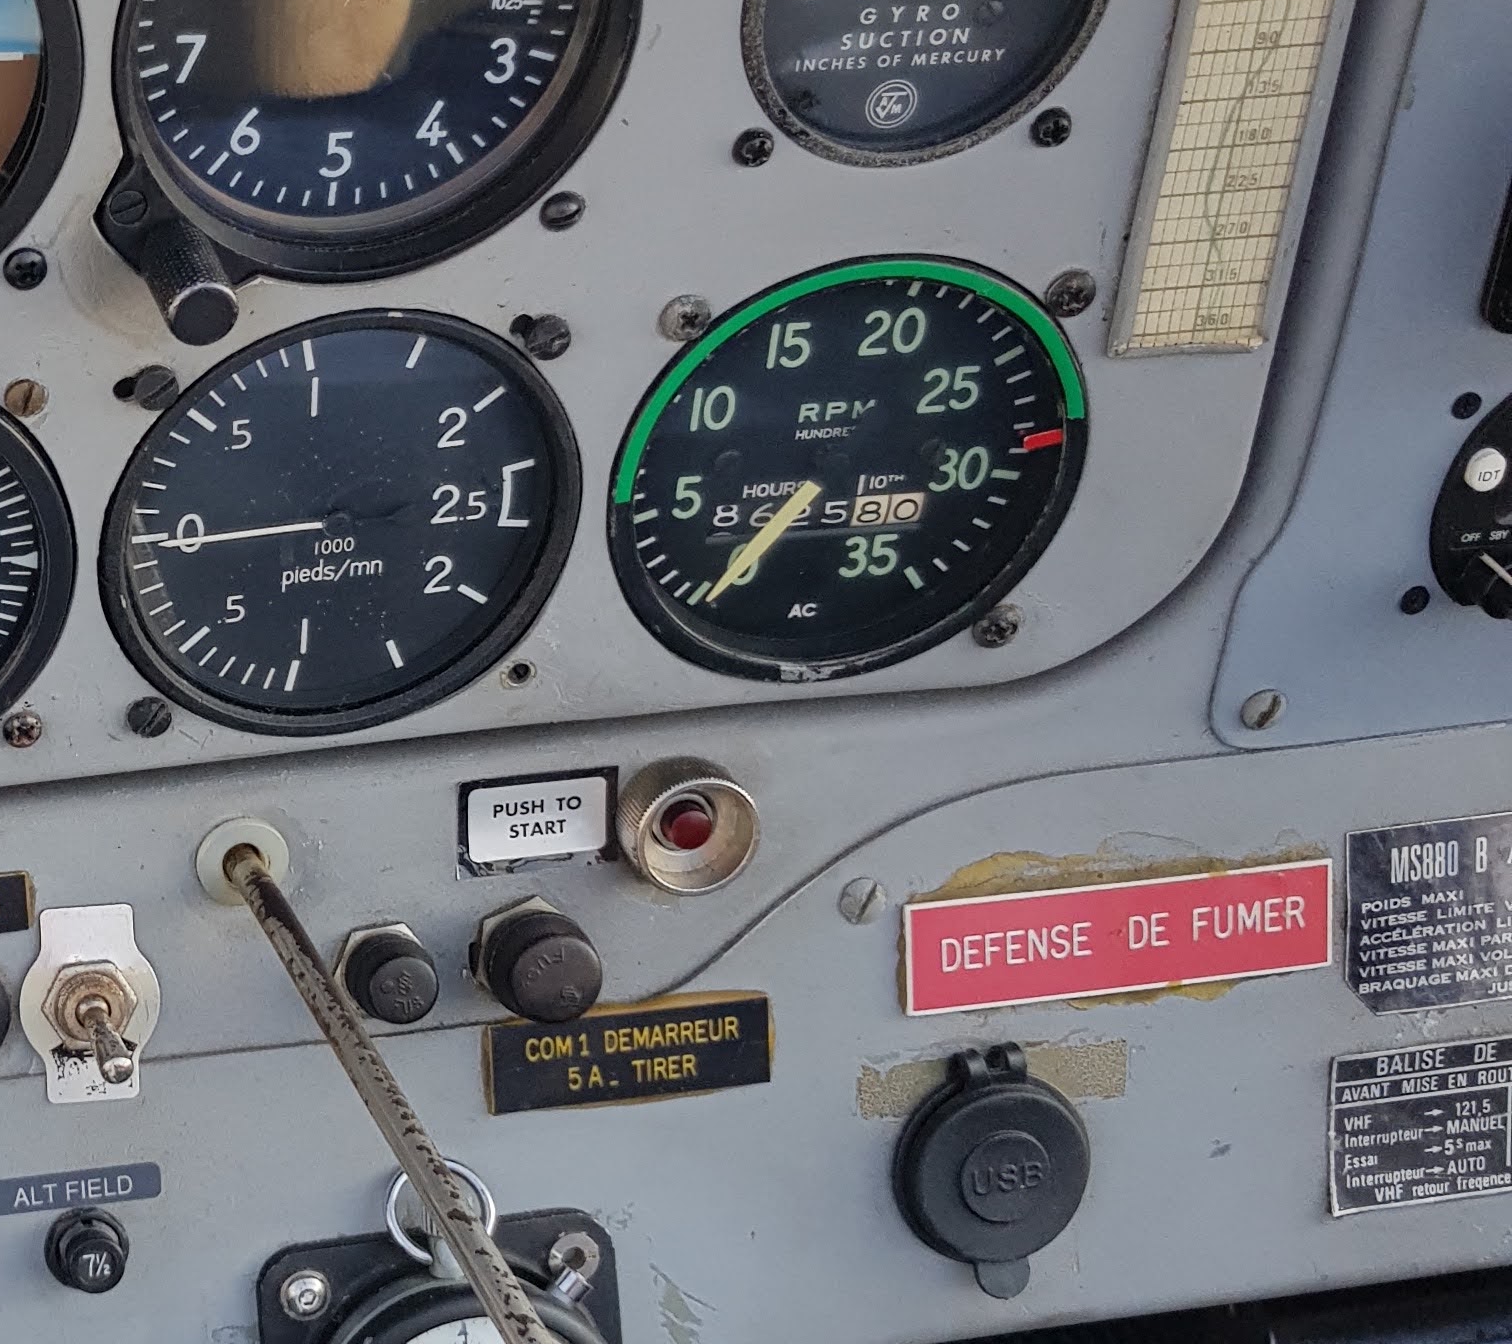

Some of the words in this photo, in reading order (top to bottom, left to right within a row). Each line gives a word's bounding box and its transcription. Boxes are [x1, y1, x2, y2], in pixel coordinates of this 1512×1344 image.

[840, 27, 971, 51] SUCTION
[1257, 30, 1280, 44] 90
[176, 34, 207, 84] 7
[484, 37, 516, 85] 3
[795, 57, 867, 73] INCHES
[877, 54, 902, 69] OF
[911, 48, 1006, 67] MERCURY
[229, 108, 261, 155] 6
[415, 100, 447, 146] 4
[1239, 127, 1272, 141] 180
[318, 131, 354, 178] 5
[1226, 173, 1258, 187] 225
[1216, 221, 1248, 236] 270
[1205, 268, 1237, 281] 315
[857, 307, 926, 357] 20
[1196, 313, 1230, 326] 360
[766, 322, 812, 369] 15
[915, 366, 981, 413] 25
[689, 385, 736, 432] 10
[437, 407, 467, 448] 2
[928, 446, 989, 493] 30
[1478, 470, 1501, 482] IDT
[430, 485, 488, 525] 2.5
[671, 476, 703, 520] 5
[175, 514, 205, 554] 0
[314, 537, 355, 555] 1000
[1460, 533, 1481, 543] OFF
[1489, 529, 1509, 541] SBY
[838, 534, 900, 578] 35
[281, 557, 383, 592] pieds/mn
[423, 556, 454, 593] 2
[787, 603, 817, 619] AC
[492, 799, 545, 818] PUSH
[556, 796, 582, 810] TO
[509, 819, 567, 838] START
[1391, 840, 1459, 883] MS880
[1475, 836, 1487, 873] B
[1361, 896, 1411, 914] POIDS
[1421, 890, 1464, 905] MAXI
[1361, 910, 1427, 929] VITESSE
[1437, 902, 1495, 919] LIMITE
[940, 921, 1093, 973] DEFENSE
[1127, 912, 1171, 950] DE
[1192, 895, 1306, 943] FUMER
[1360, 920, 1486, 946] ACCÉLÉRATION
[1359, 942, 1427, 962] VITESSE
[1432, 937, 1474, 952] MAXI
[1359, 959, 1427, 978] VITESSE
[1432, 953, 1474, 969] MAXI
[1359, 973, 1452, 995] BRAQUAGE
[1455, 968, 1498, 982] MAXI
[604, 1016, 740, 1054] DEMARREUR
[631, 1054, 697, 1083] TIRER
[1376, 1048, 1445, 1076] BALISE
[1473, 1042, 1498, 1063] DE
[1341, 1082, 1390, 1102] AVANT
[1402, 1076, 1438, 1093] MISE
[1448, 1072, 1467, 1088] EN
[1344, 1115, 1372, 1131] VHF
[1455, 1099, 1491, 1117] 121.5
[1345, 1128, 1424, 1148] Interrupteur
[1446, 1117, 1505, 1134] MANUEL
[1344, 1155, 1378, 1169] Essai
[1465, 1140, 1491, 1152] max
[971, 1161, 1045, 1196] USB
[1346, 1167, 1425, 1188] Interrupteur
[1447, 1156, 1485, 1175] AUTO
[13, 1183, 57, 1208] ALT
[65, 1175, 133, 1201] FIELD
[1375, 1184, 1403, 1202] VHF
[1412, 1181, 1450, 1197] retour
